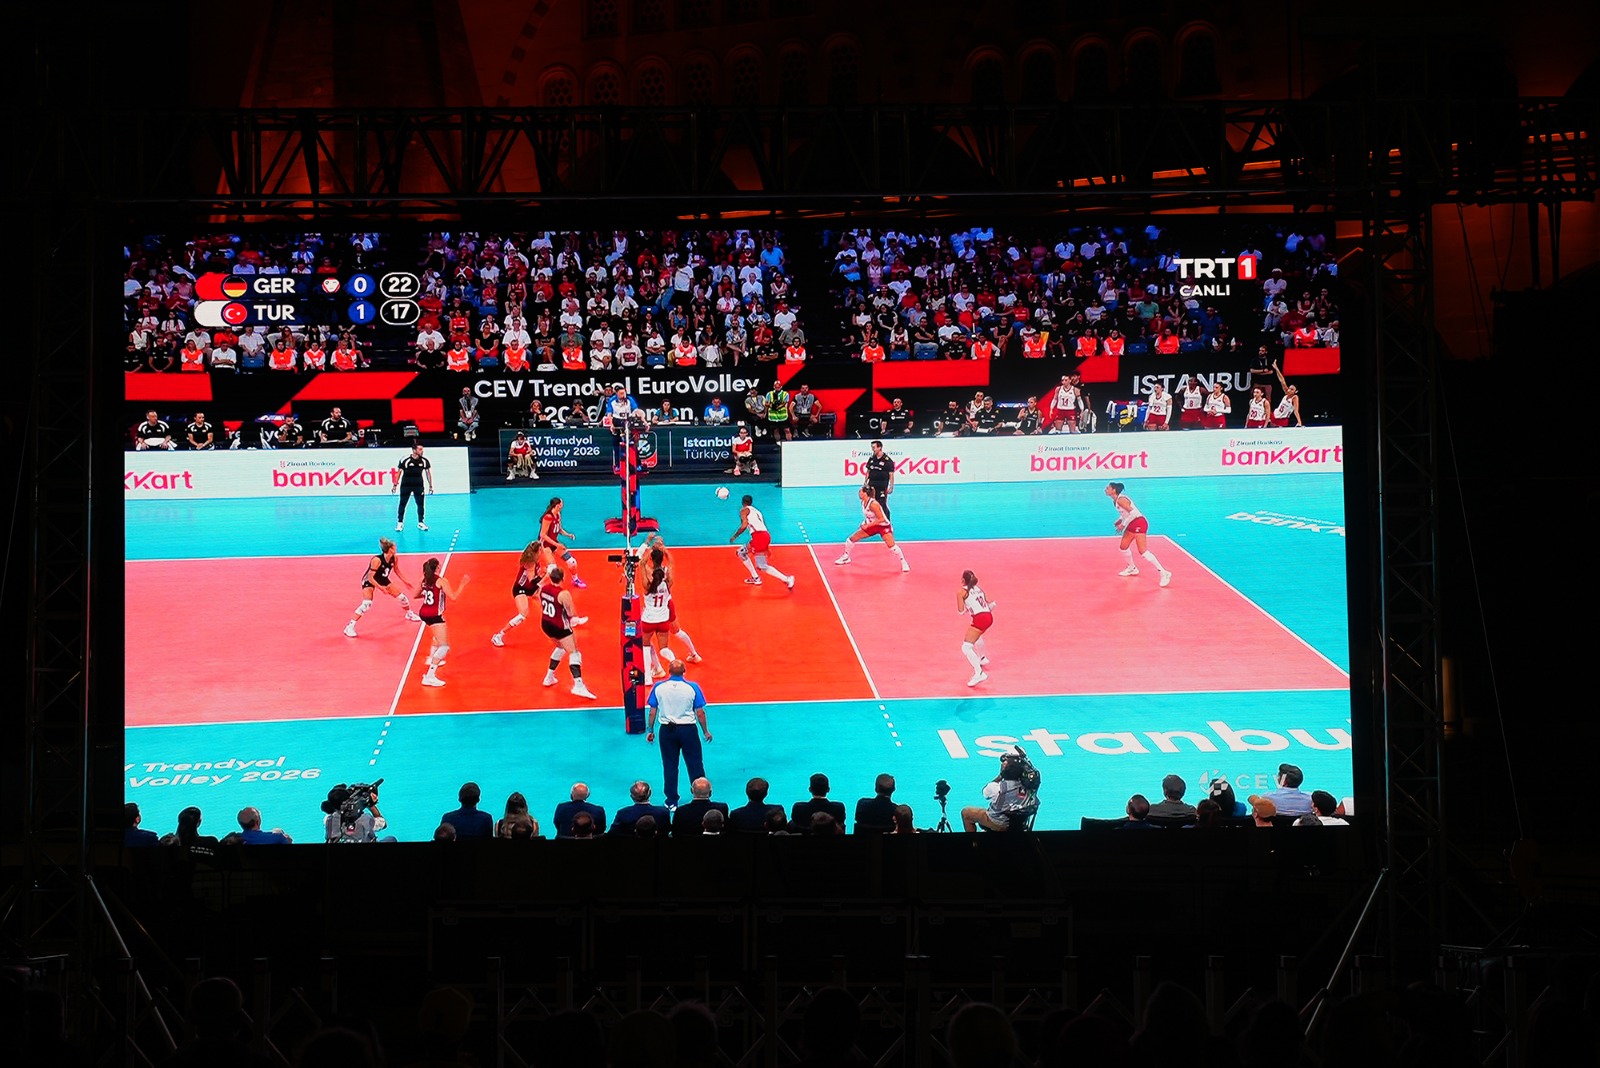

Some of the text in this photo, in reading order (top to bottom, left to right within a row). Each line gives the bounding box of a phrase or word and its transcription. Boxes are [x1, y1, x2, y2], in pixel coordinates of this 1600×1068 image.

[1173, 257, 1253, 278] TRT 1
[253, 276, 417, 294] GER 0 22
[1179, 284, 1231, 296] CANLI
[253, 304, 411, 321] TUR 1 17
[474, 379, 524, 398] CEV
[638, 373, 760, 396] EuroVolley
[1133, 372, 1252, 395] ISTANBU
[544, 405, 600, 423] 206
[525, 434, 593, 447] EV Trendyol
[532, 446, 600, 457] oVolley 2026
[683, 449, 730, 461] Türkiye
[536, 458, 578, 468] Women
[541, 600, 556, 618] 20
[652, 594, 664, 608] 11
[936, 718, 1352, 759] Istanbu
[143, 756, 287, 774] Trendyol
[127, 768, 322, 789] Volley 2026
[1235, 773, 1288, 790] CEV
